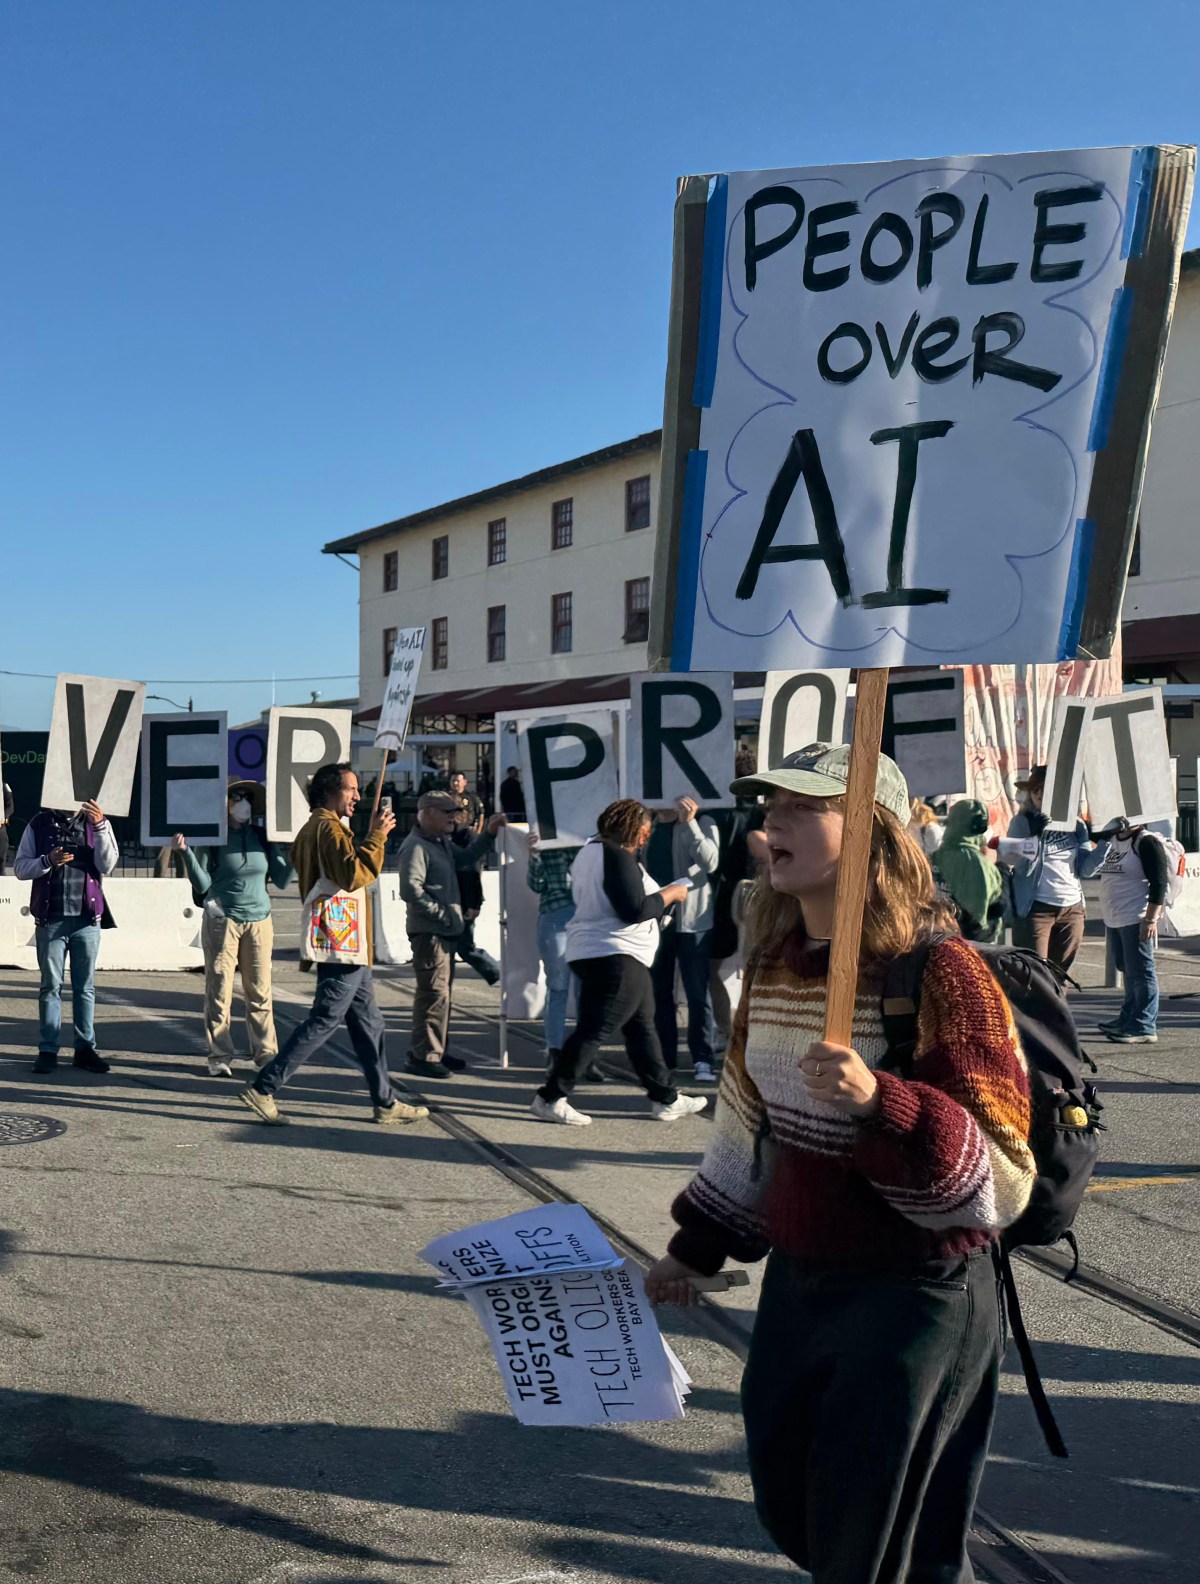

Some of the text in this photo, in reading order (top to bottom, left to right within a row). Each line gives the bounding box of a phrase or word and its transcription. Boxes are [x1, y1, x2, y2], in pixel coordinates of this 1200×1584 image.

[744, 182, 1104, 294] PEOPLE
[735, 420, 956, 610] AI
[1, 750, 47, 764] DevDa
[609, 1284, 633, 1344] WORKERS
[618, 1270, 643, 1326] BAY AREA
[488, 1288, 537, 1402] TECH WOR
[527, 1338, 562, 1405] MUST
[626, 1346, 643, 1381] TECH
[583, 1349, 634, 1417] TECH
